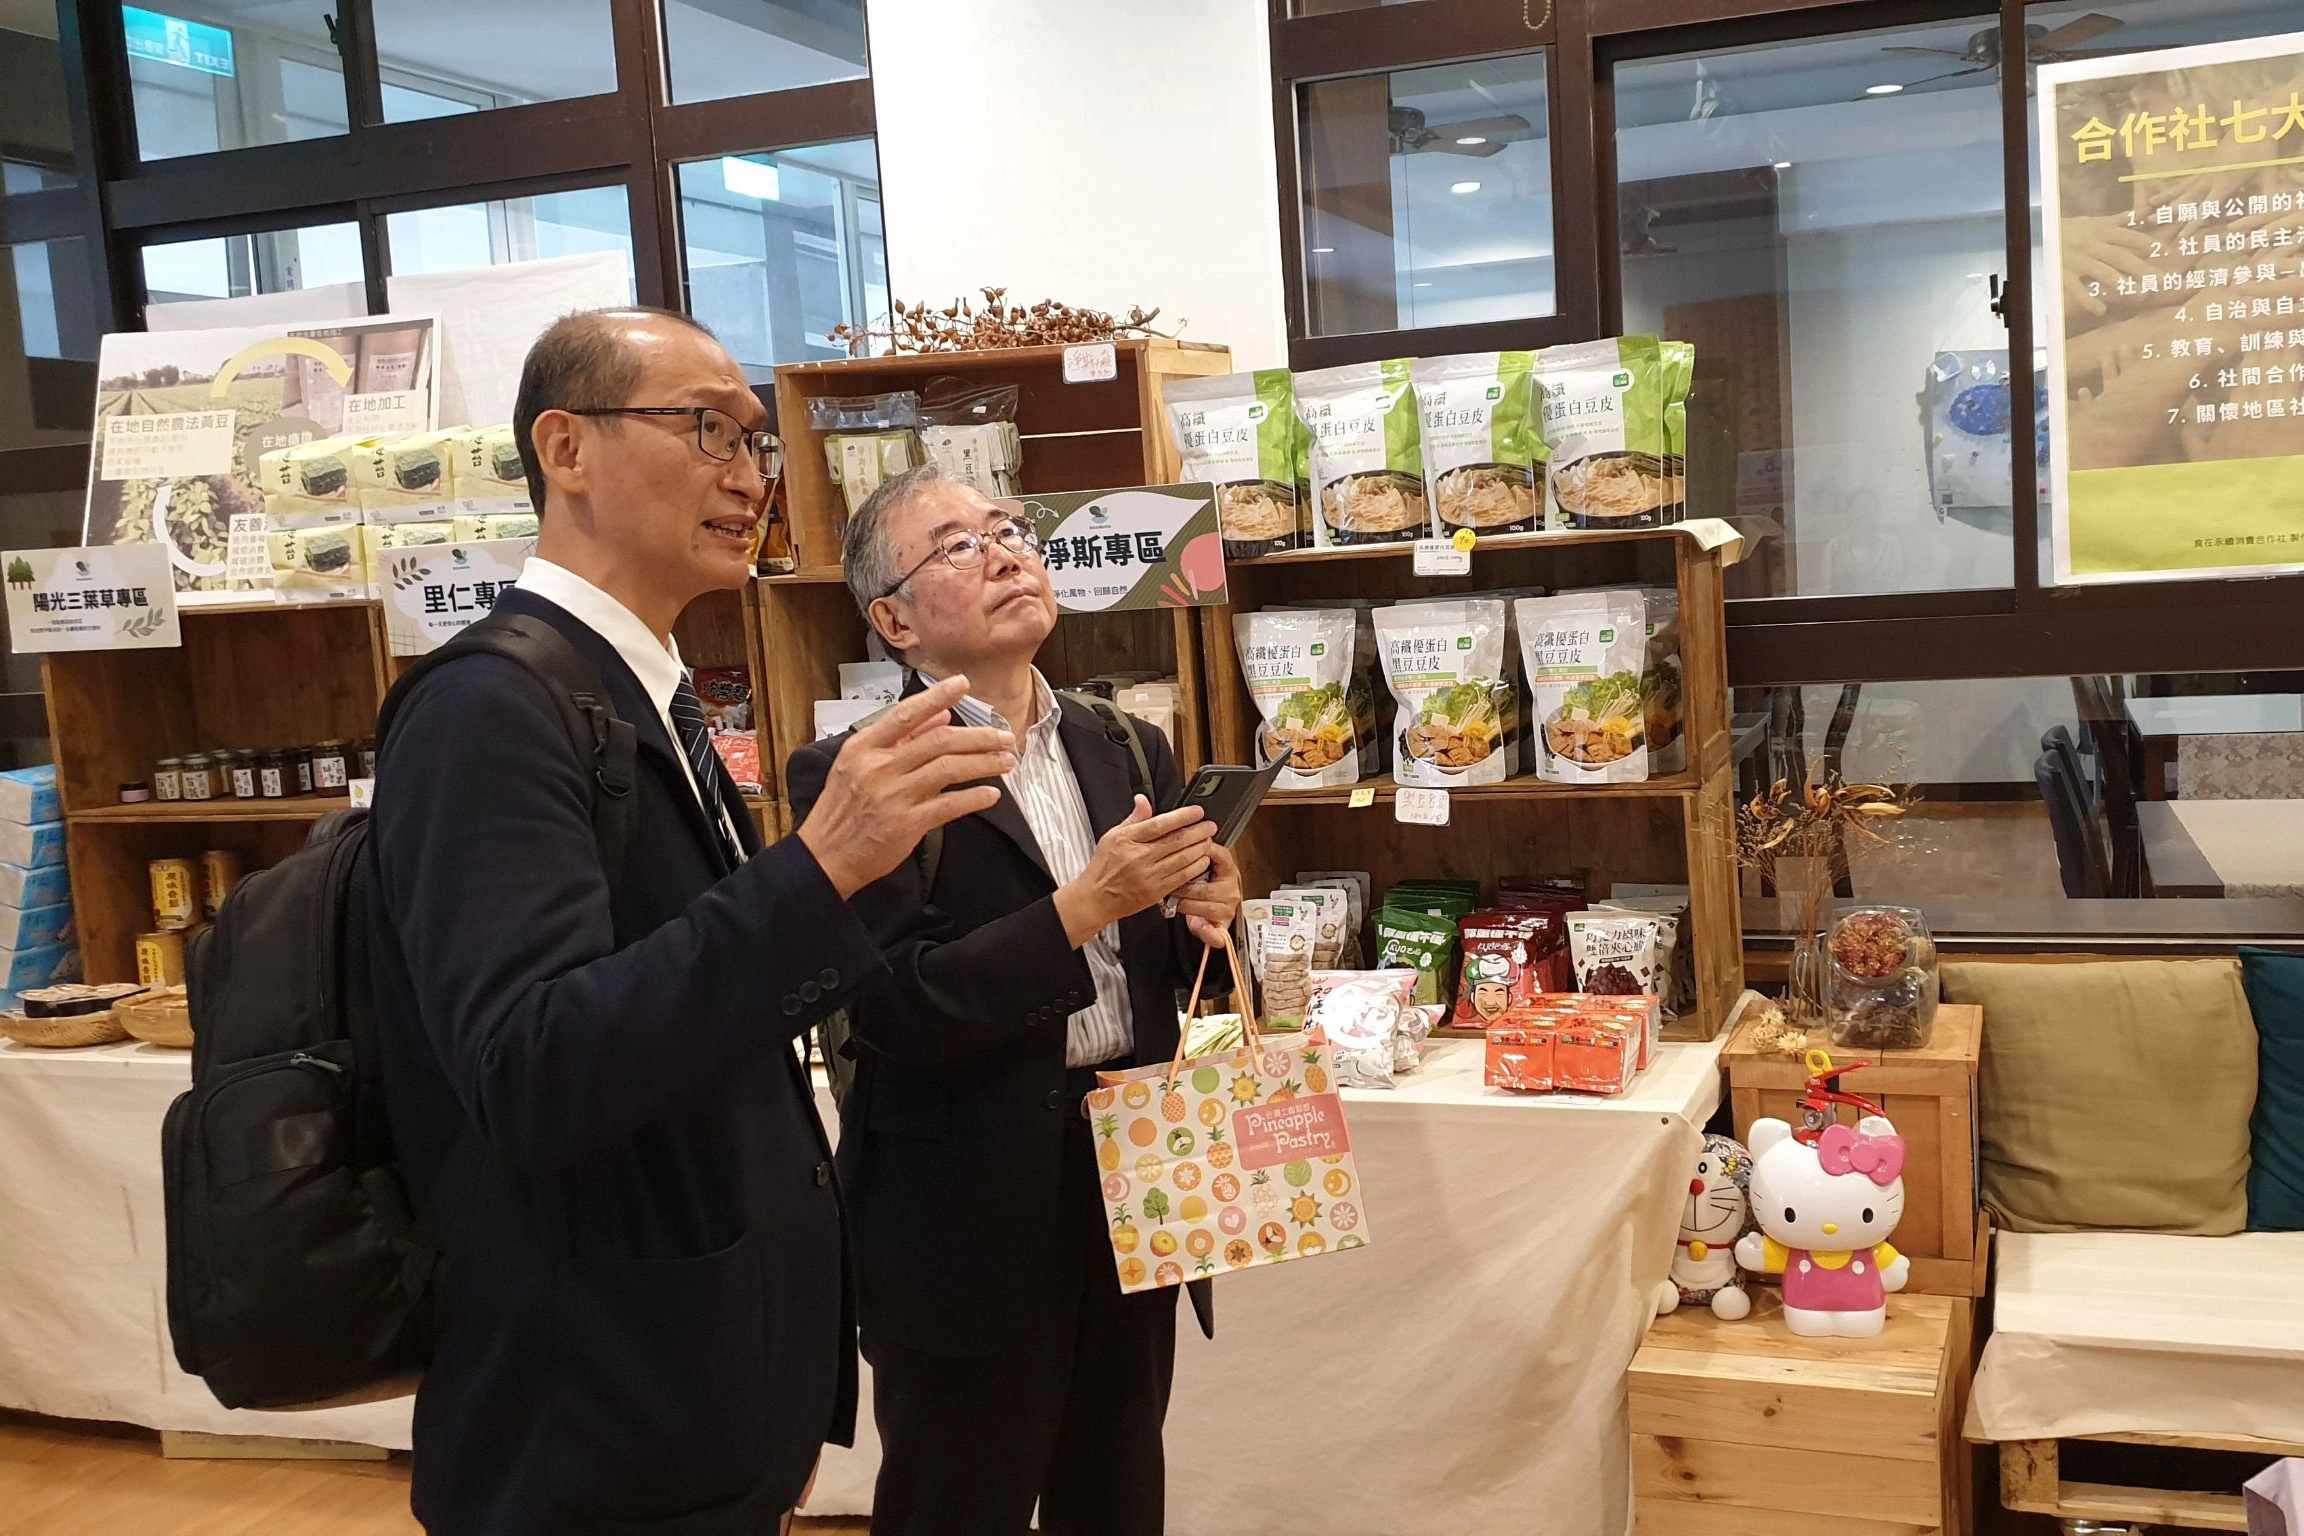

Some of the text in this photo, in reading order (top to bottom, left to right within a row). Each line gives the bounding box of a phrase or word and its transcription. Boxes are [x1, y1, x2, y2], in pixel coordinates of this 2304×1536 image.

[2071, 92, 2304, 163] 合作社七大
[2127, 210, 2145, 227] 1.
[2150, 241, 2168, 258] 2.
[2089, 281, 2107, 297] 3.
[2174, 296, 2304, 322] 4. 自治與自
[2142, 343, 2161, 359] 5.
[2189, 363, 2304, 388] 6. 社間合作
[348, 395, 405, 413] 在地加工
[2167, 408, 2186, 424] 7.
[963, 449, 973, 481] 黑豆
[233, 518, 268, 532] 友善
[1041, 531, 1167, 571] 淨斯專區
[33, 587, 149, 613] 陽光三葉草專區
[1244, 1105, 1325, 1136] Pineapple
[1272, 1128, 1331, 1154] Pastry
